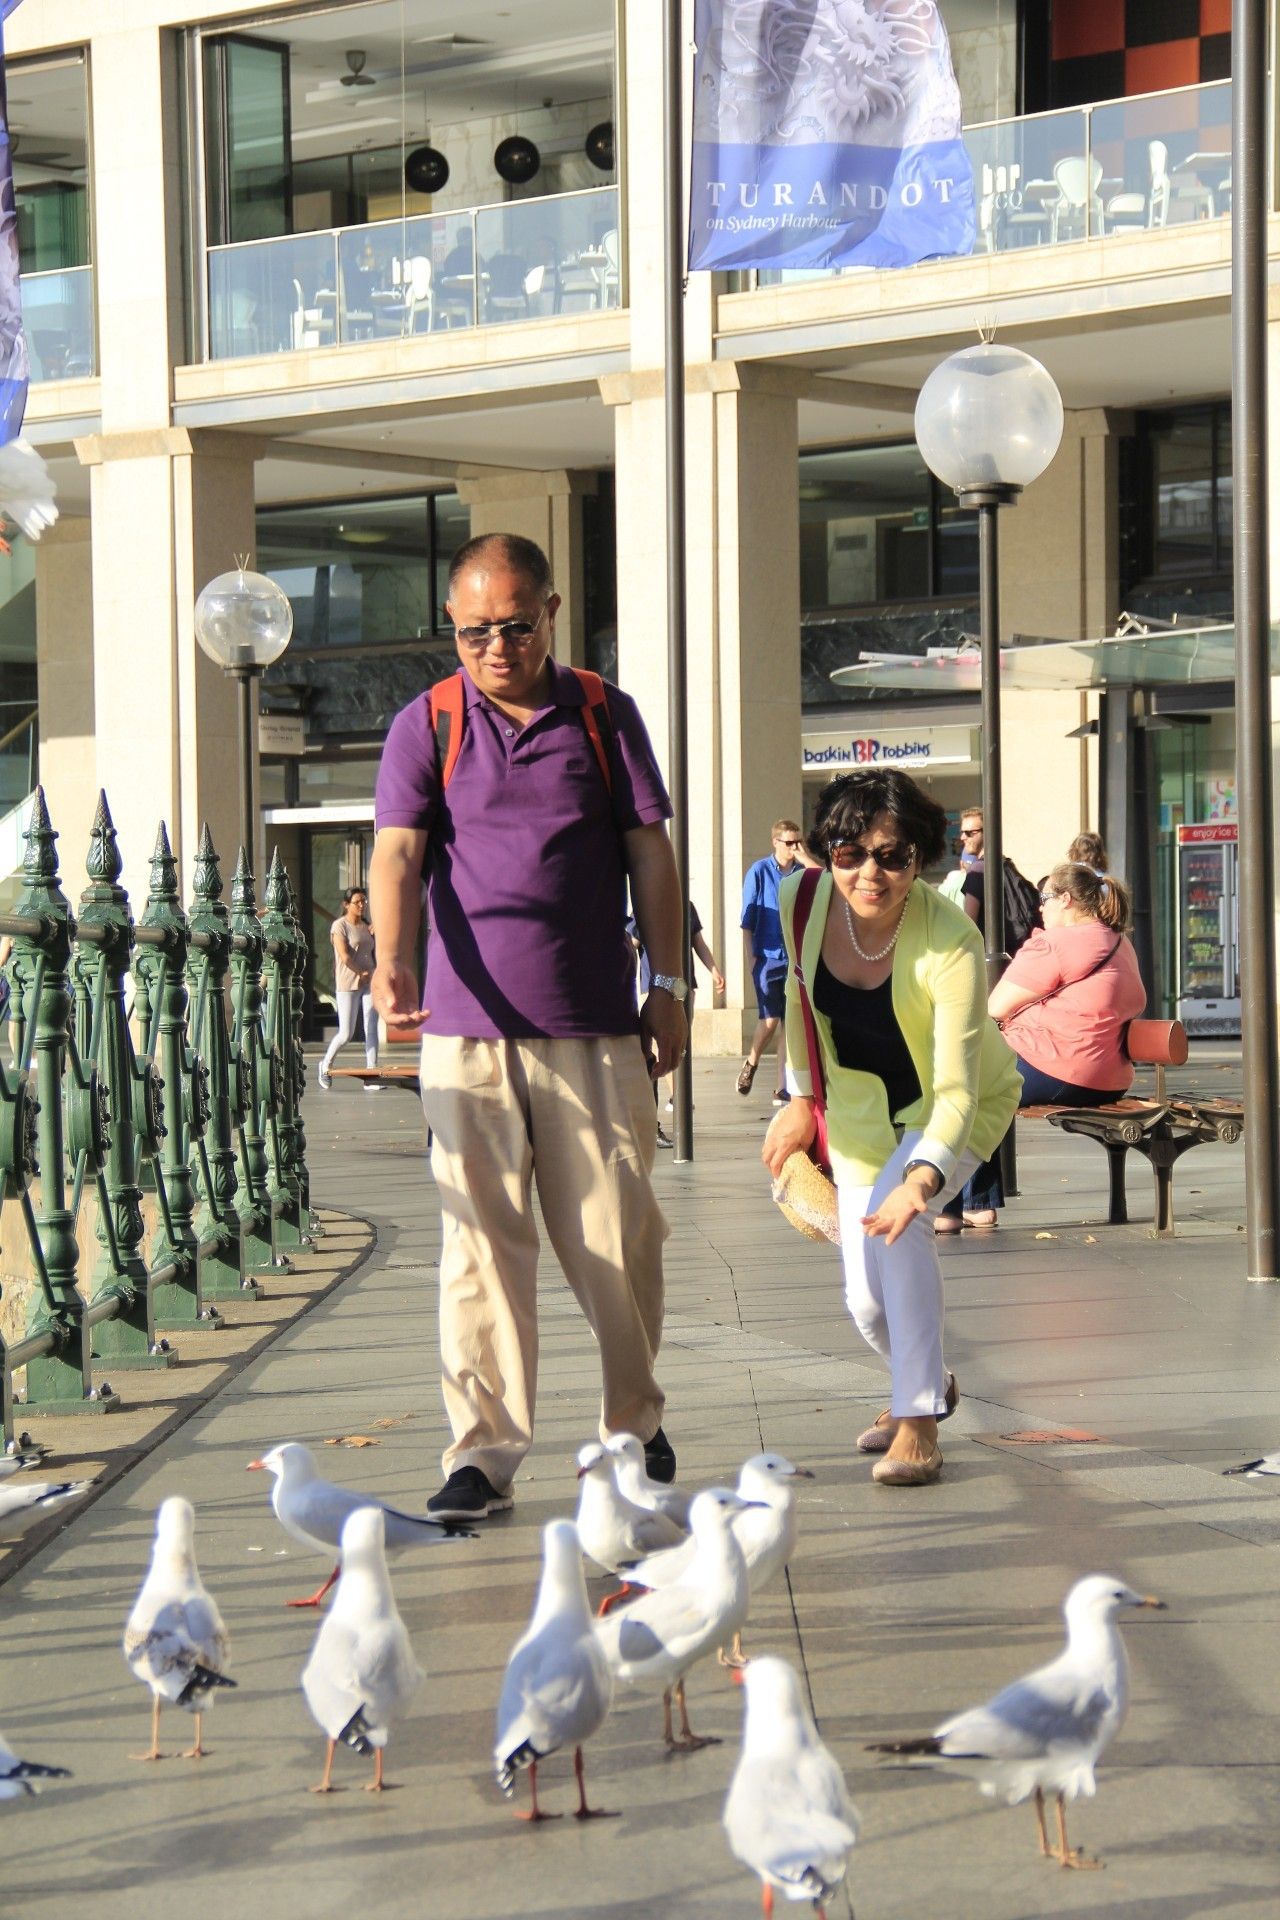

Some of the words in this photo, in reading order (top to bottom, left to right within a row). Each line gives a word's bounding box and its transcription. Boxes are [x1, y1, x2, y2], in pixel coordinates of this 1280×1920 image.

[707, 178, 954, 210] TURANDOT
[706, 216, 724, 230] on
[727, 215, 779, 234] Sydney
[781, 213, 842, 230] Harbour
[852, 739, 881, 763] BR
[1192, 827, 1217, 839] enjoy
[1218, 826, 1232, 836] ice
